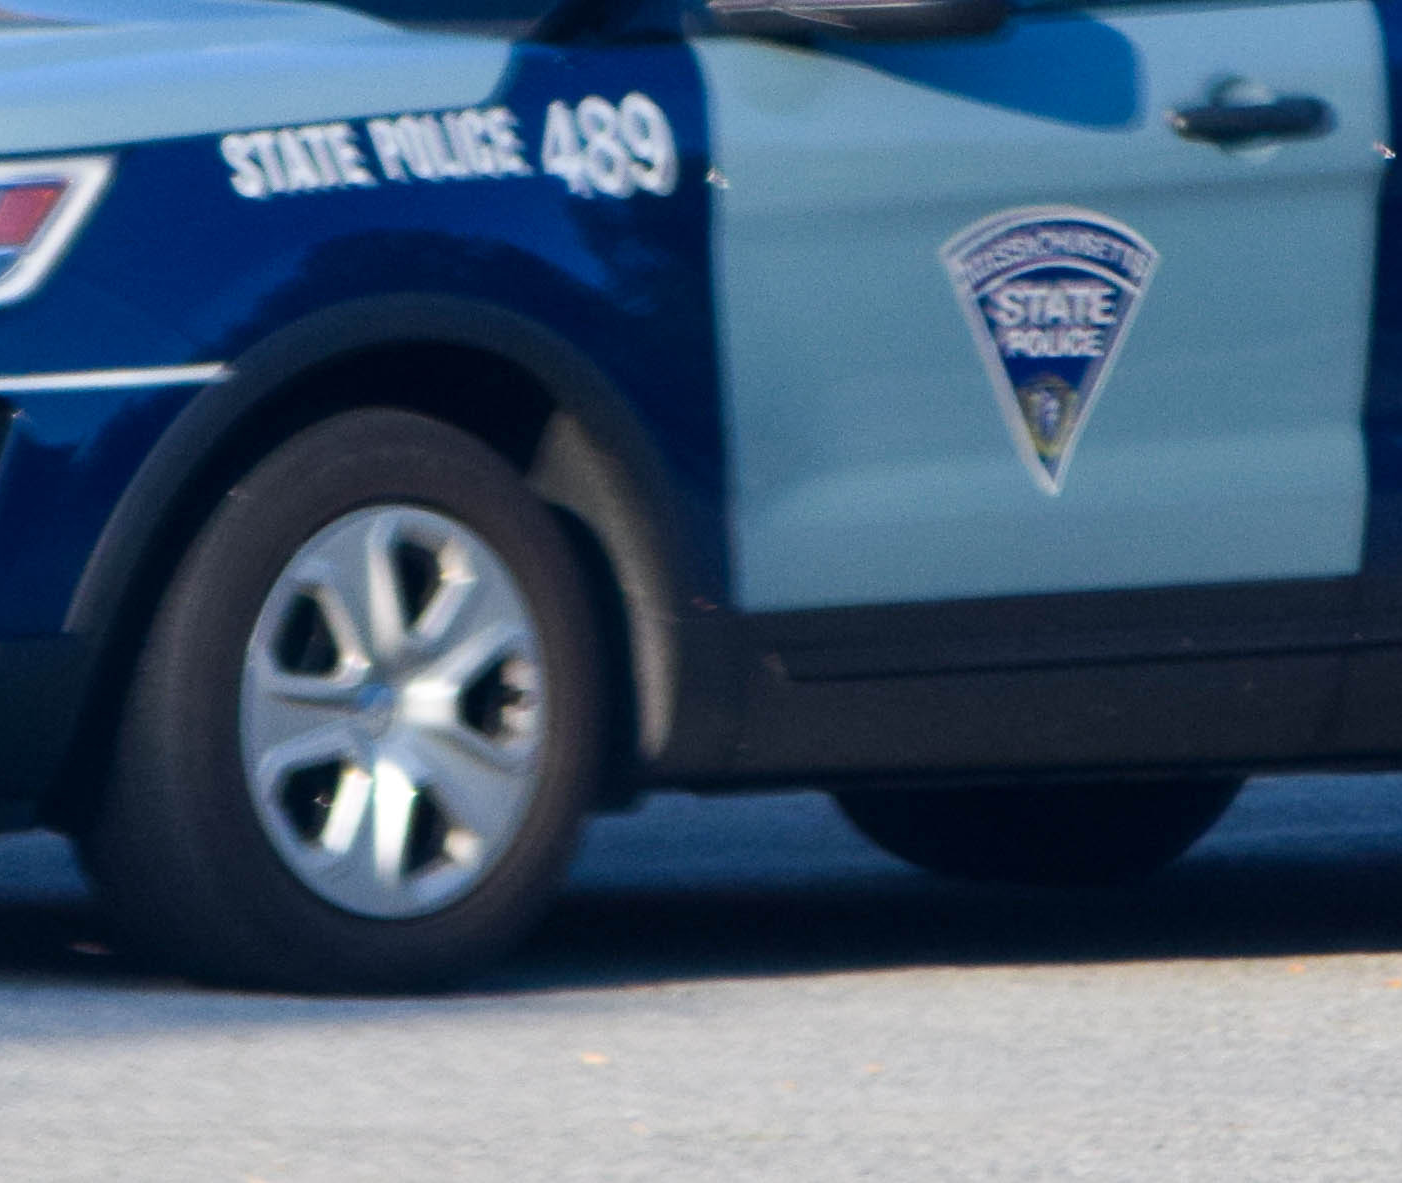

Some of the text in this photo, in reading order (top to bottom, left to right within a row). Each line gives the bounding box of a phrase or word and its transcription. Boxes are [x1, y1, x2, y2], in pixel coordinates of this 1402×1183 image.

[220, 90, 681, 200] STATE POLICE 489
[993, 283, 1118, 327] STATE
[1002, 327, 1105, 358] POLICE
